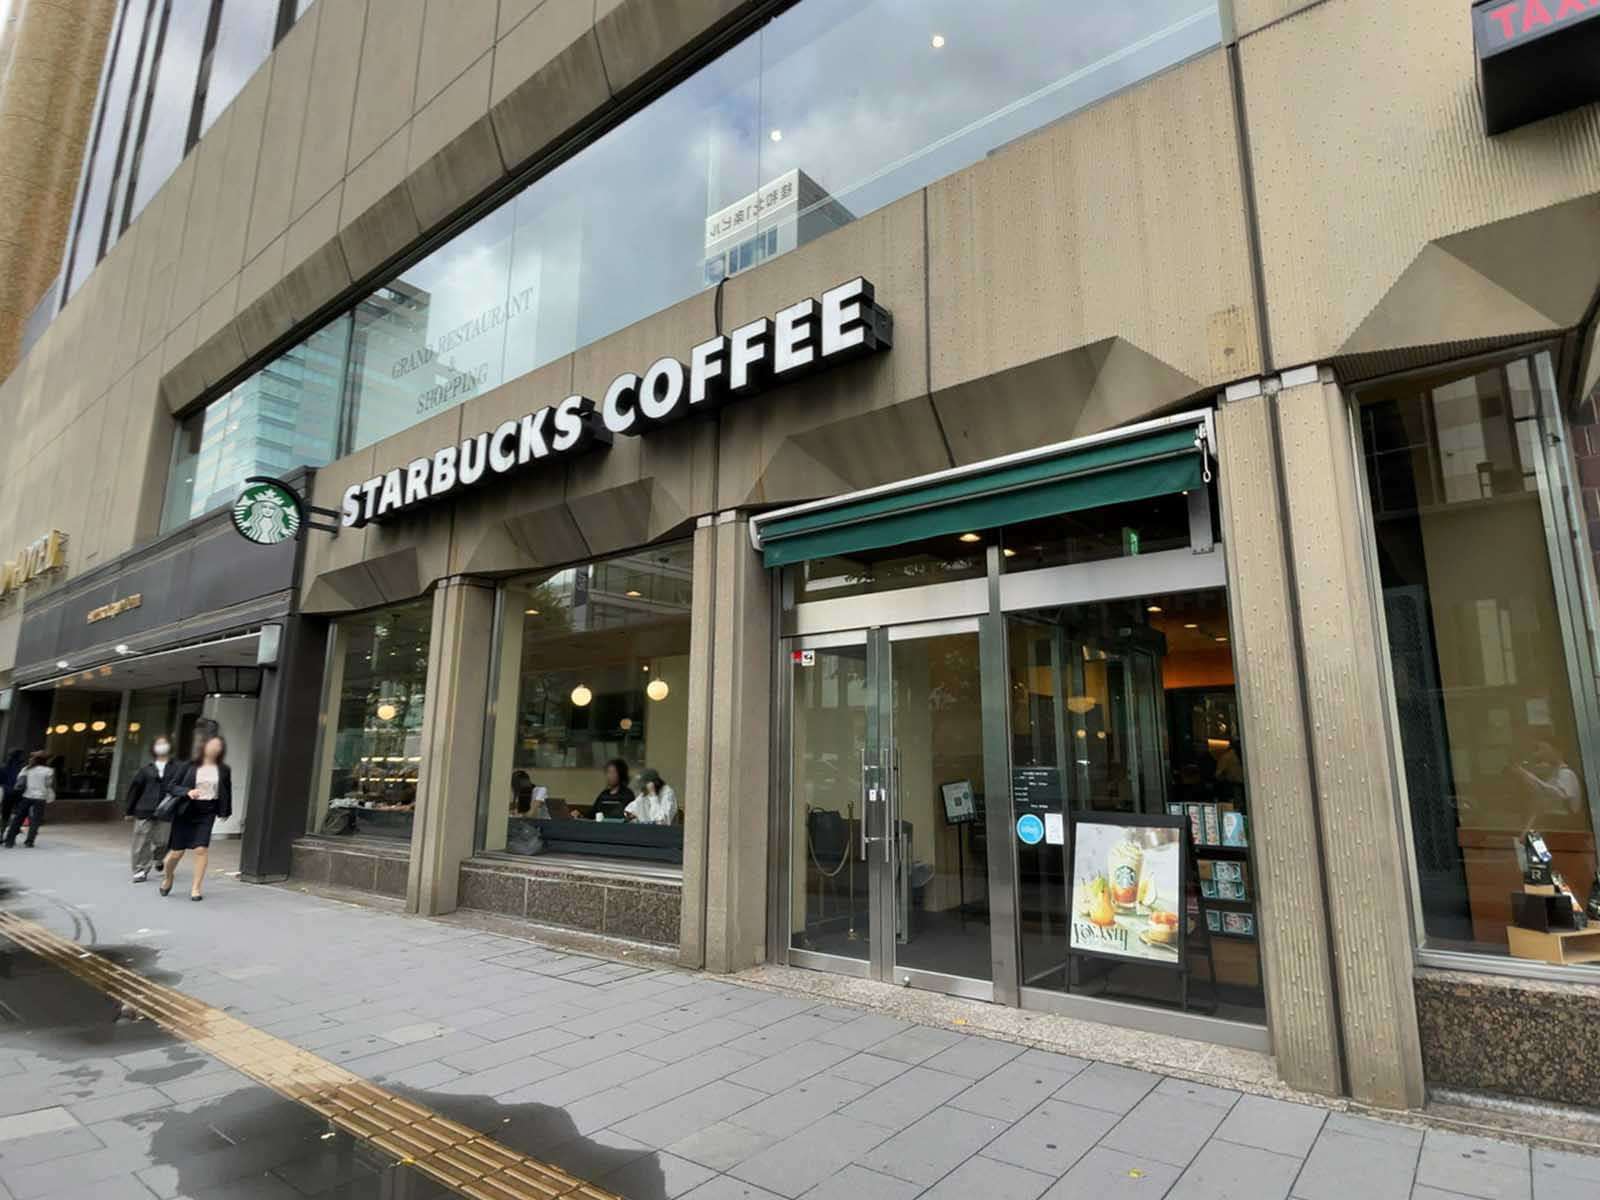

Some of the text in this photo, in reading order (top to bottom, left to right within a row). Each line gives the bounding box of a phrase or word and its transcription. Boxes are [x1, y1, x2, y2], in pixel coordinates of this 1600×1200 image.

[391, 288, 534, 379] GRAND RESTAURANT
[342, 276, 866, 528] STARBUCKS COFFEE
[416, 362, 489, 414] SHOPPING
